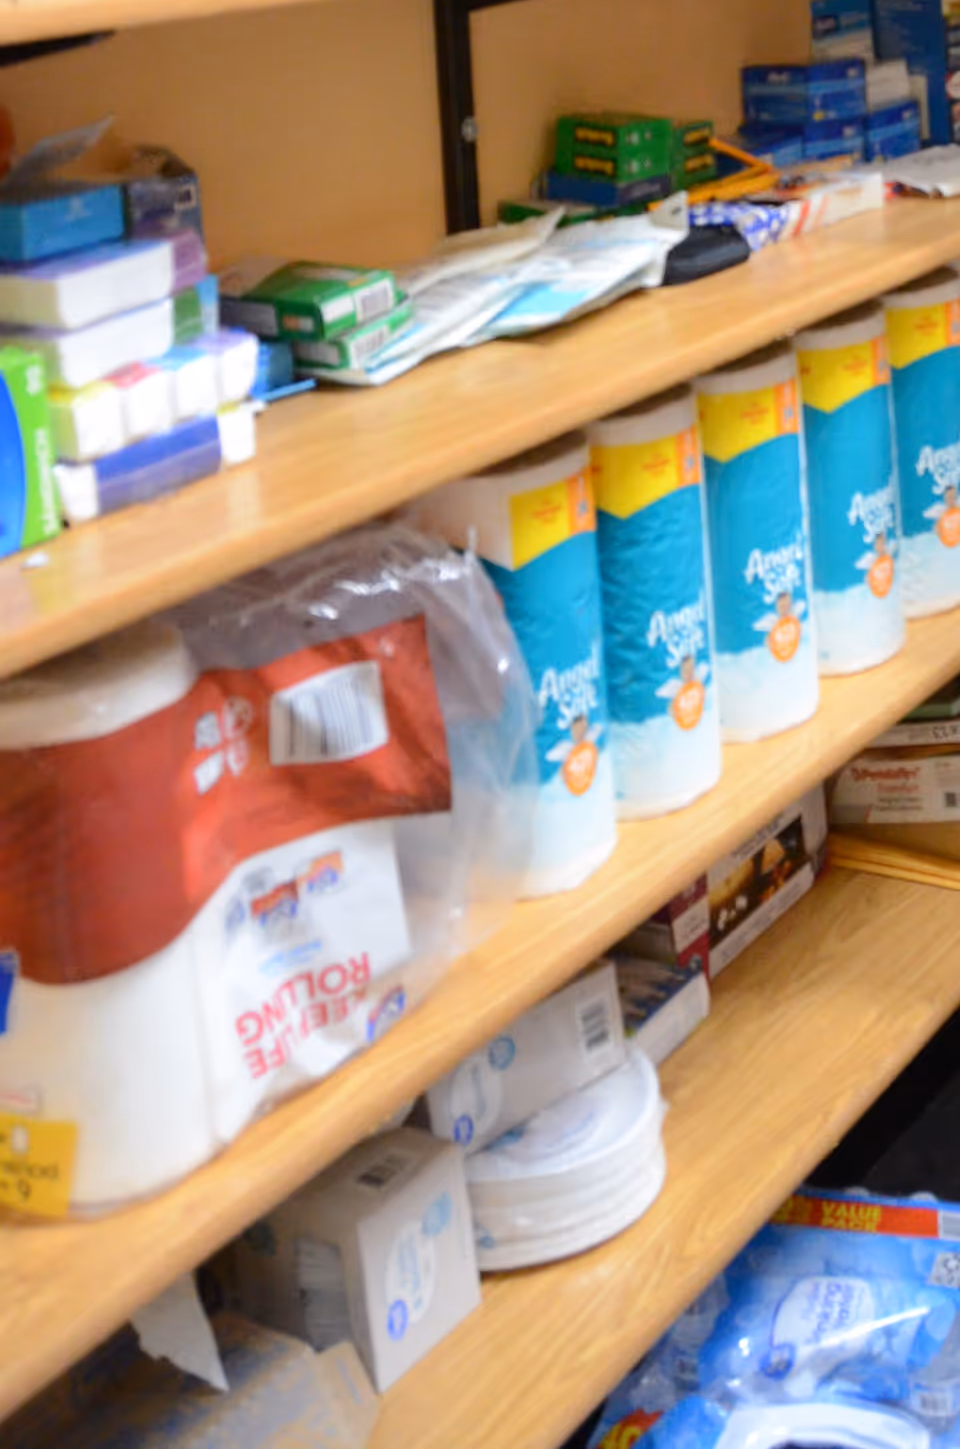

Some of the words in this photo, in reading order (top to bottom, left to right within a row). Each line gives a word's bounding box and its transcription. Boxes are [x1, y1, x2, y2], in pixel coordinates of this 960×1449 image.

[538, 643, 600, 708] Angel
[234, 951, 371, 1049] ROLLING
[821, 1200, 882, 1220] VALUE
[821, 1217, 878, 1233] PACK
